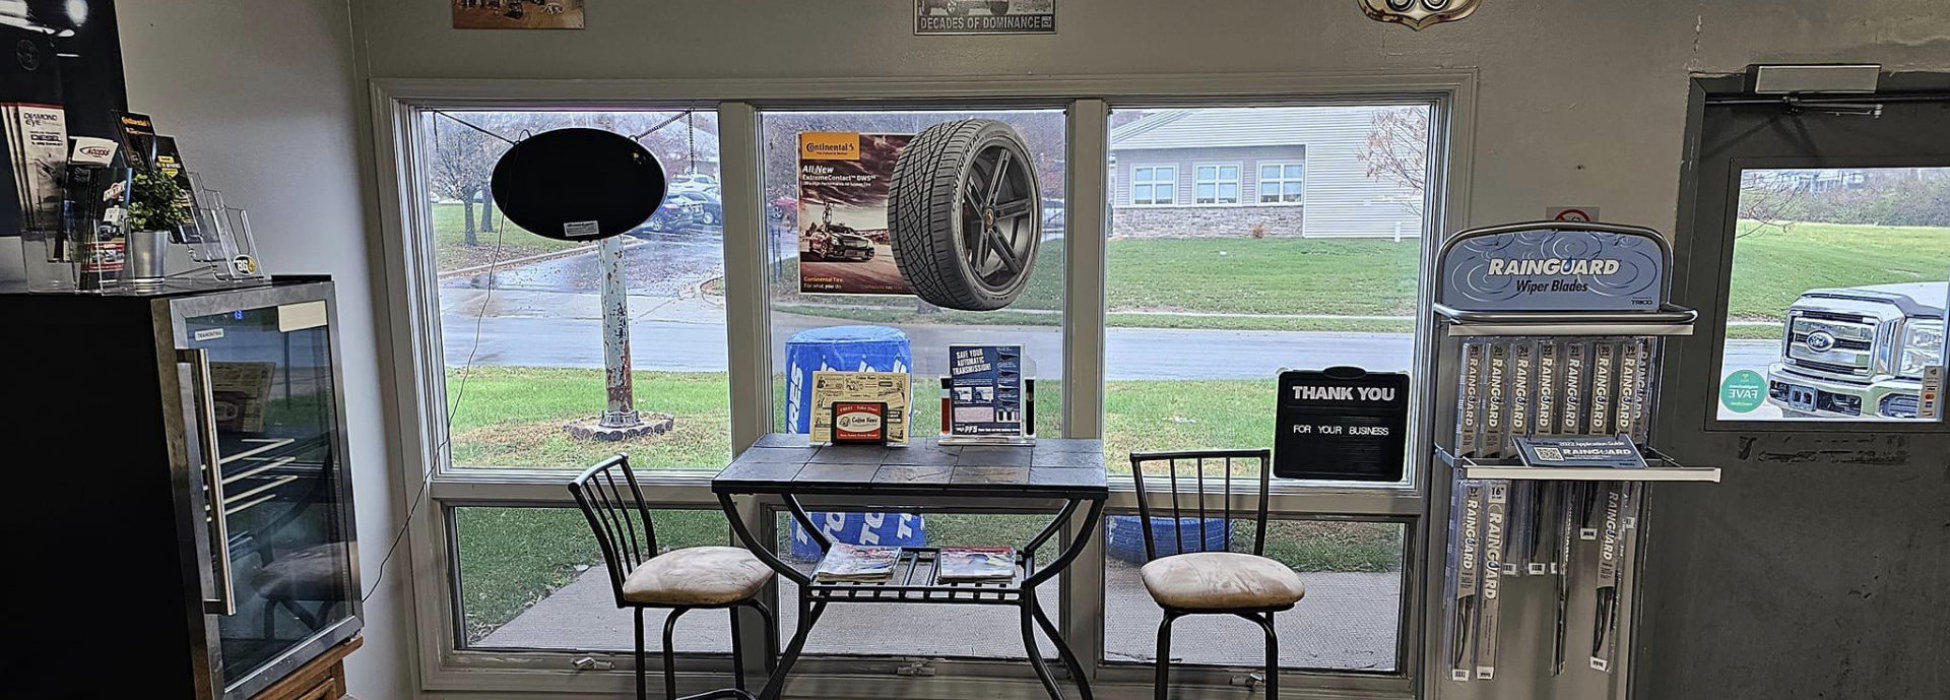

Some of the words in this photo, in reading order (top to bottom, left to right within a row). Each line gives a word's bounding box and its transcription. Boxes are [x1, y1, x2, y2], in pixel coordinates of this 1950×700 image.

[920, 17, 964, 29] DECADES
[967, 17, 980, 28] OF
[982, 16, 1040, 28] DOMINANCE
[23, 112, 58, 121] DIAMOND
[806, 142, 848, 153] Continental
[1488, 257, 1620, 275] RAINGUARD
[1515, 279, 1550, 295] Wiper
[1550, 279, 1589, 293] Blades
[956, 350, 969, 359] SAVE
[969, 348, 984, 357] YOUR
[957, 356, 985, 366] AUTOMATIC
[1292, 386, 1354, 400] THANK
[1357, 387, 1396, 401] YOU
[1465, 358, 1479, 426] RAINGUARD
[1489, 358, 1503, 427] RAINGUARD
[1513, 359, 1529, 428] RAINGUARD
[1539, 357, 1553, 427] RAINGUARD
[1565, 358, 1580, 427] RAINGUARD
[1593, 357, 1609, 427] RAINGUARD
[1620, 357, 1636, 427] RAINGUARD
[1293, 425, 1312, 434] FOR
[1318, 425, 1342, 435] YOUR
[1349, 426, 1389, 436] BUSINESS
[1462, 499, 1479, 570] RAINGUARD
[1483, 511, 1504, 600] RAINGUARD
[1602, 491, 1620, 561] RAINGUARD
